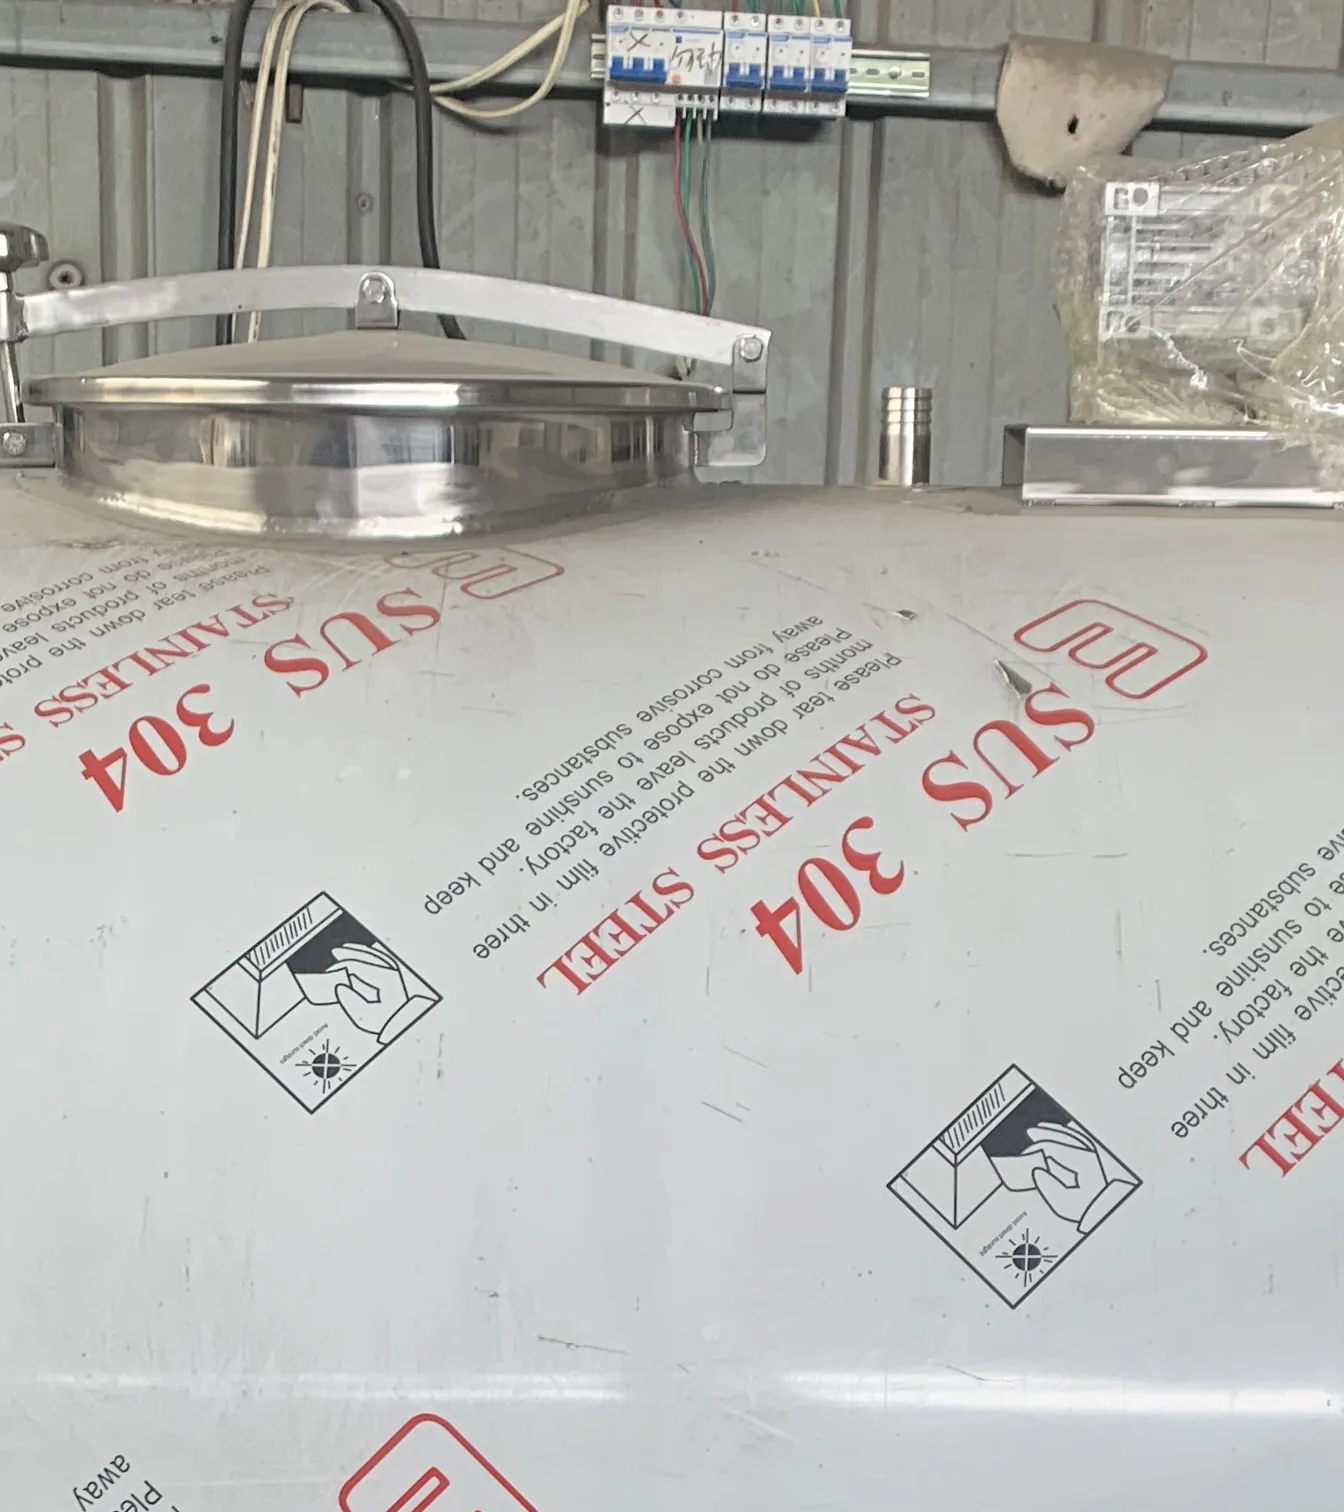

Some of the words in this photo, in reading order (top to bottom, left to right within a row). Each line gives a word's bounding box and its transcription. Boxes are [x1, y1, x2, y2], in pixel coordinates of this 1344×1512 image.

[154, 588, 197, 612] tear
[89, 607, 146, 638] down
[263, 587, 442, 697] SUS
[35, 592, 295, 728] STAINLESS
[48, 637, 87, 659] the
[802, 638, 874, 680] months
[778, 678, 802, 699] of
[832, 651, 903, 692] Please
[692, 690, 779, 751] products
[790, 690, 836, 721] tear
[78, 683, 235, 813] 304
[732, 718, 789, 757] down
[920, 686, 1098, 832] SUS
[635, 749, 697, 792] leave
[696, 755, 737, 784] the
[697, 693, 936, 874] STAINLESS
[596, 791, 637, 820] the
[597, 778, 696, 858] protective
[518, 818, 600, 877] factory.
[554, 857, 600, 891] film
[750, 816, 906, 975] 304
[527, 890, 559, 913] in
[1302, 895, 1333, 918] to
[471, 912, 532, 960] three
[536, 866, 695, 996] STEEL
[1214, 918, 1303, 998] sunshine
[1168, 999, 1213, 1045] and
[1250, 1022, 1297, 1061] film
[1116, 1038, 1176, 1090] keep
[1224, 1060, 1257, 1086] in
[1169, 1086, 1230, 1139] three
[71, 1453, 132, 1512] away
